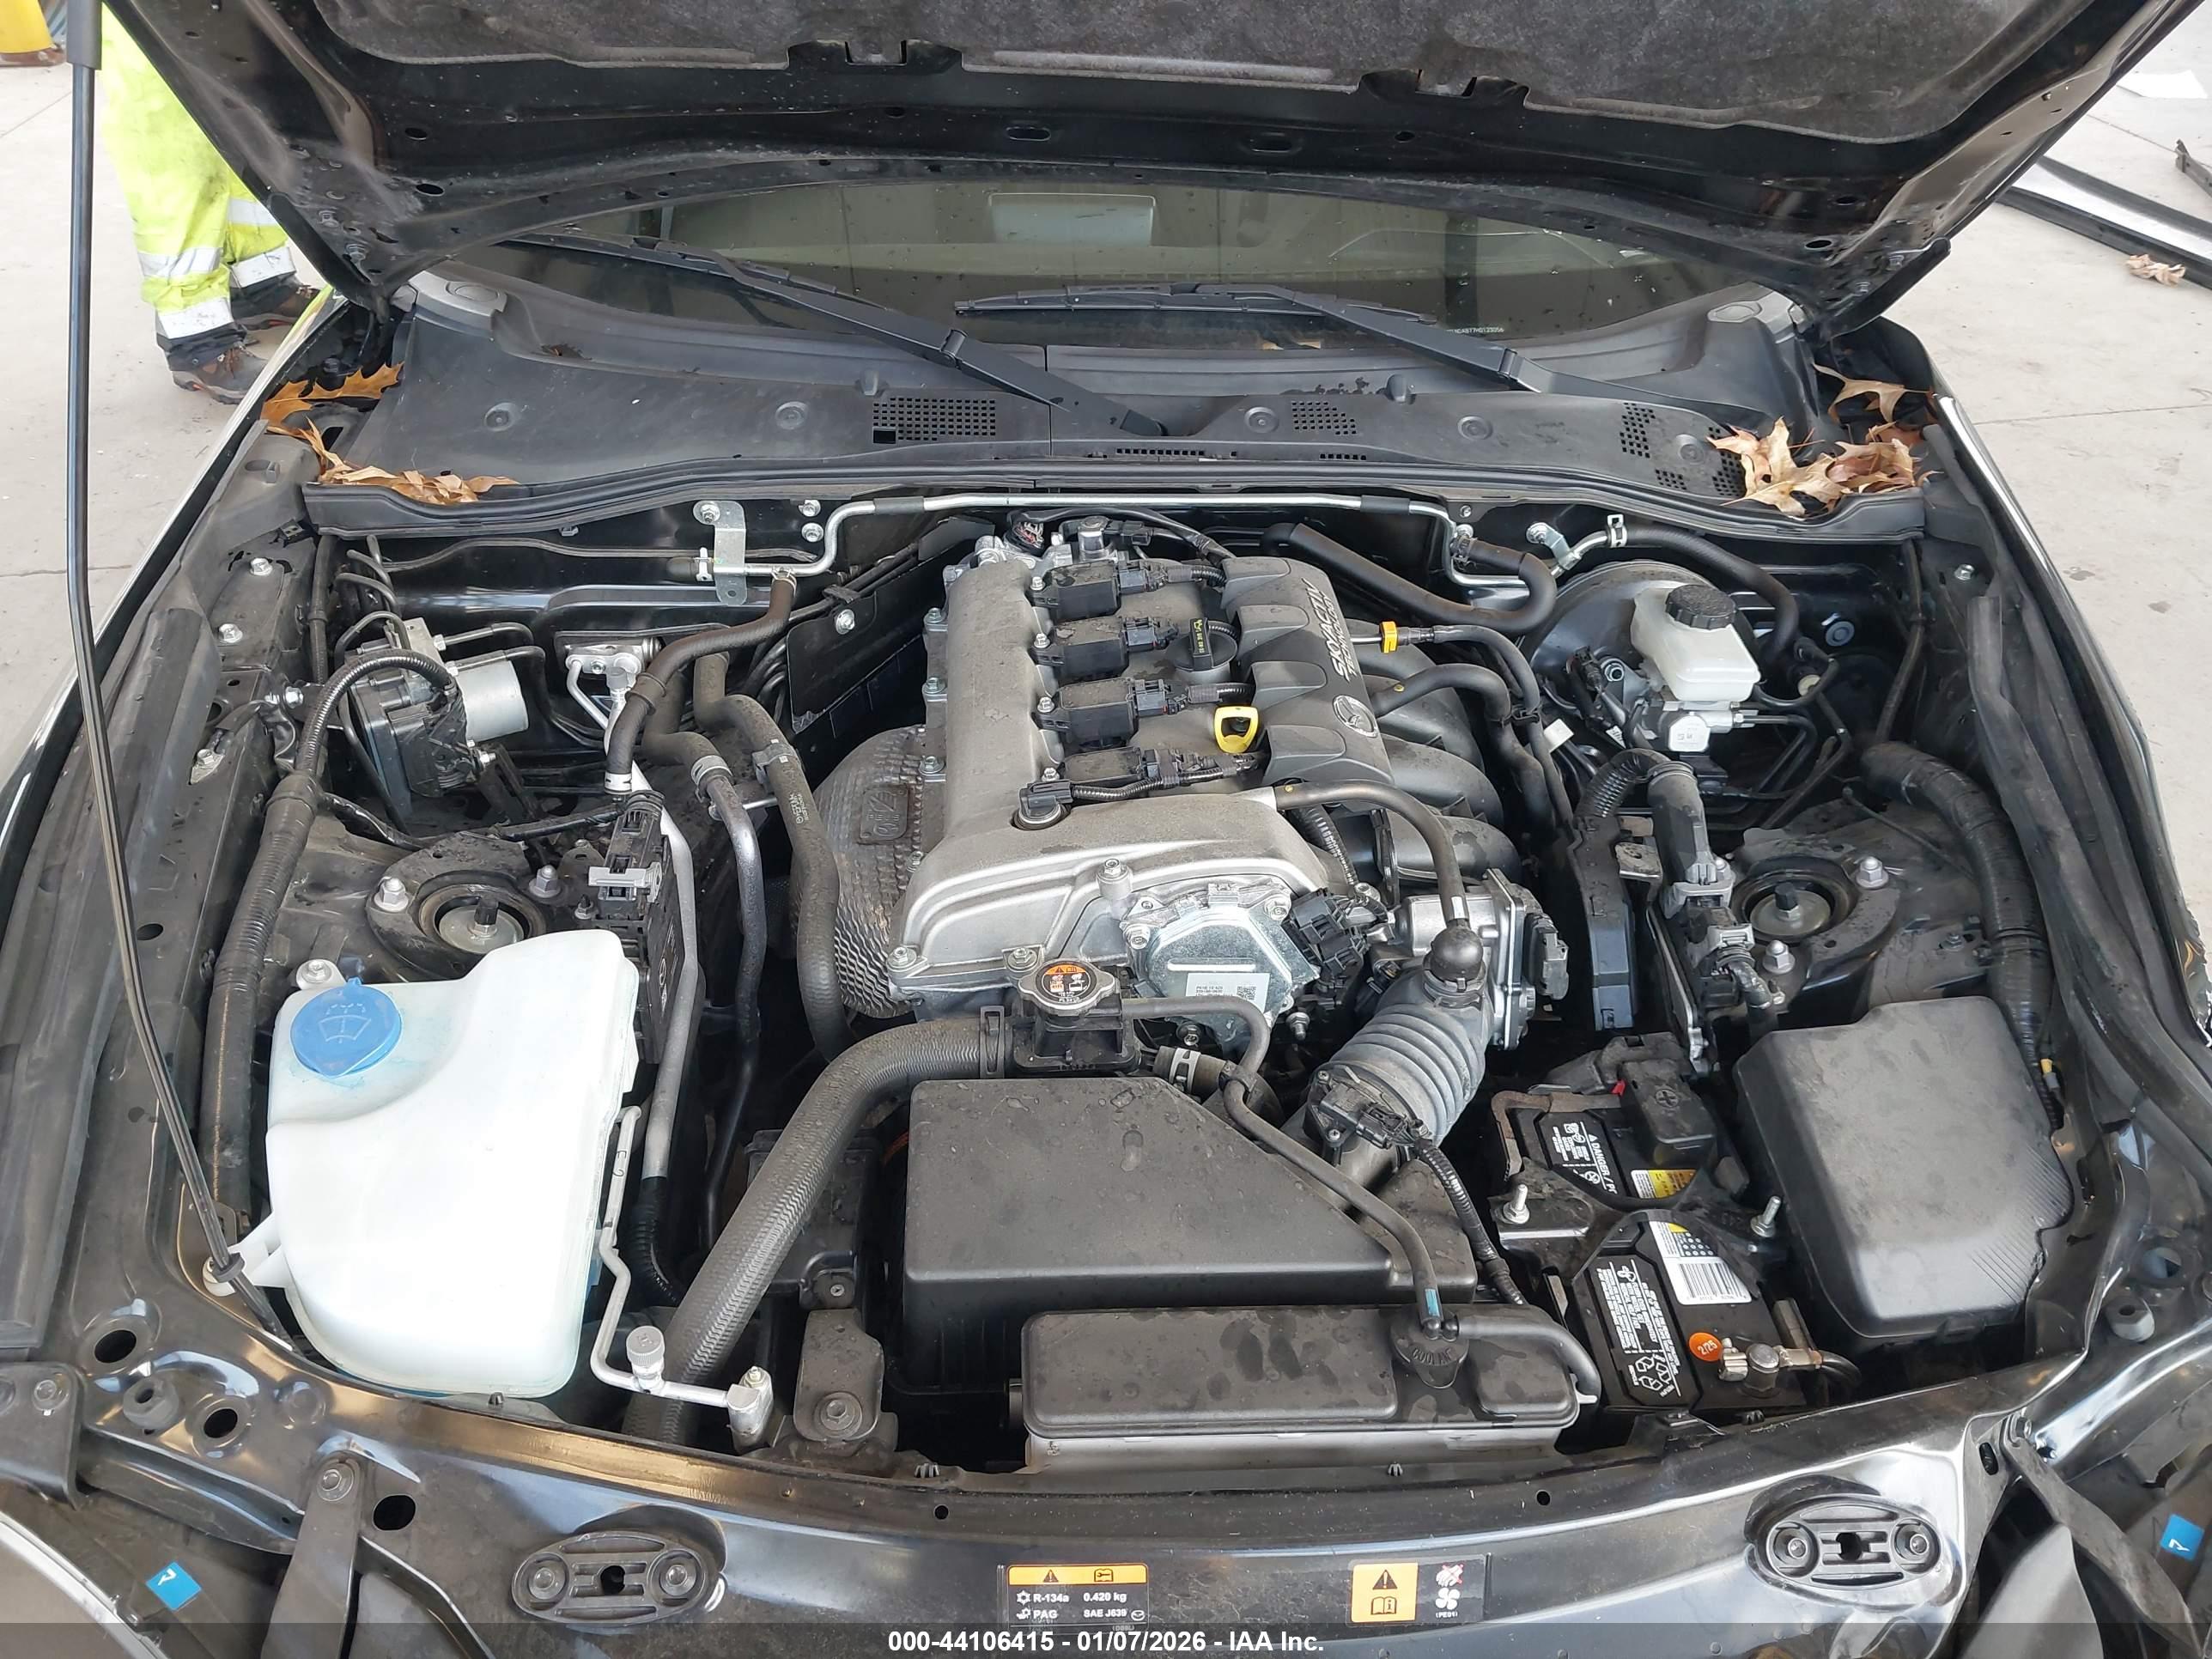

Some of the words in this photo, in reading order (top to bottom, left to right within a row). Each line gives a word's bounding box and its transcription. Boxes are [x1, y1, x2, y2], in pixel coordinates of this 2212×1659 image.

[1302, 577, 1350, 684] SKYACTIV
[1320, 591, 1358, 677] TECHNOLOGY
[1591, 1142, 1611, 1176] DANGER
[1697, 1340, 1718, 1355] 2/25
[1033, 1593, 1070, 1603] R-134a
[1083, 1592, 1111, 1602] 0.420
[1114, 1592, 1127, 1603] kg
[1033, 1609, 1058, 1620] PAG
[1083, 1609, 1103, 1618] SAE
[1105, 1608, 1127, 1618] J639
